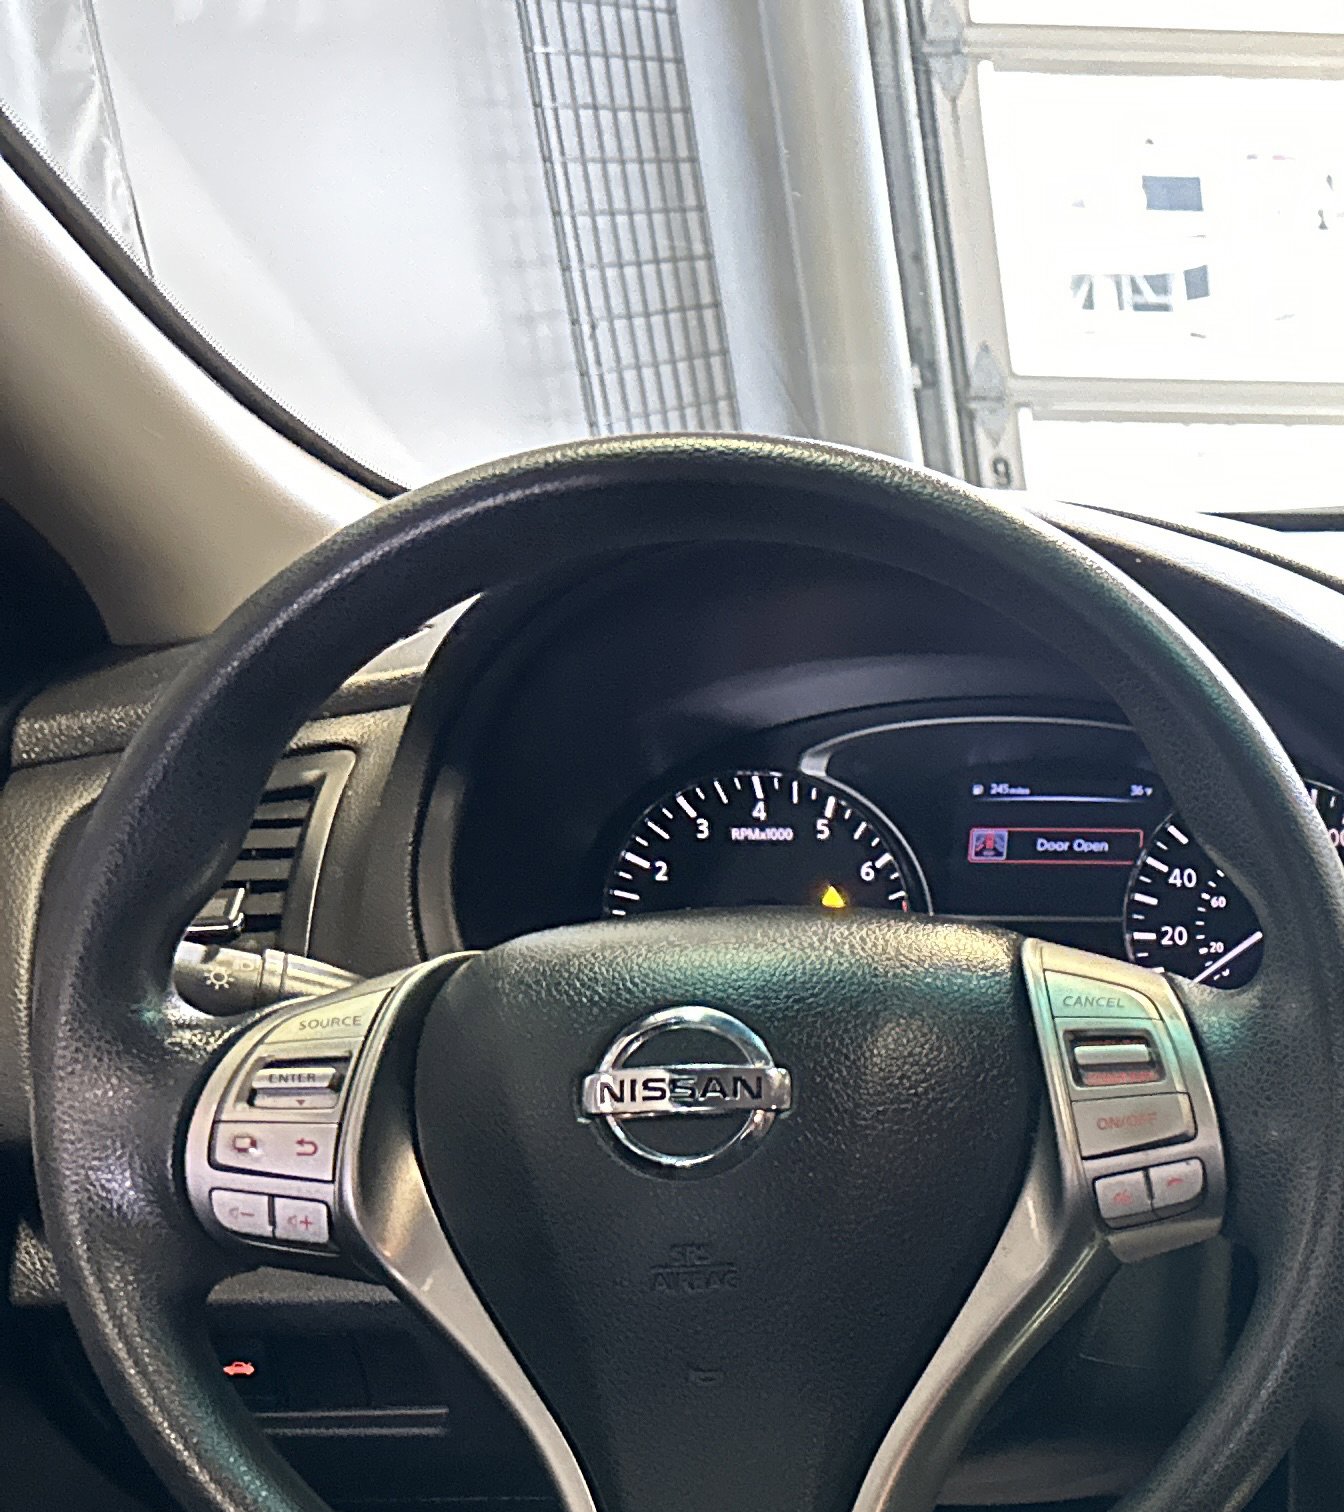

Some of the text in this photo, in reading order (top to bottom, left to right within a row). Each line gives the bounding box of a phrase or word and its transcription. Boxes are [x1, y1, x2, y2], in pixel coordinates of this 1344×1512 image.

[752, 801, 766, 821] 4
[696, 818, 709, 840] 3
[816, 818, 830, 840] 5
[1036, 838, 1109, 852] Door Open
[655, 861, 668, 881] 2
[860, 861, 875, 881] 6
[1168, 868, 1197, 888] 40
[1211, 896, 1226, 908] 60
[1160, 926, 1188, 946] 20
[1210, 941, 1224, 953] 20
[1063, 995, 1125, 1008] CANCEL
[299, 1015, 362, 1031] SOURCE
[268, 1073, 317, 1084] ENTER
[600, 1075, 763, 1105] NISSAN
[1096, 1111, 1158, 1130] ON/OFF
